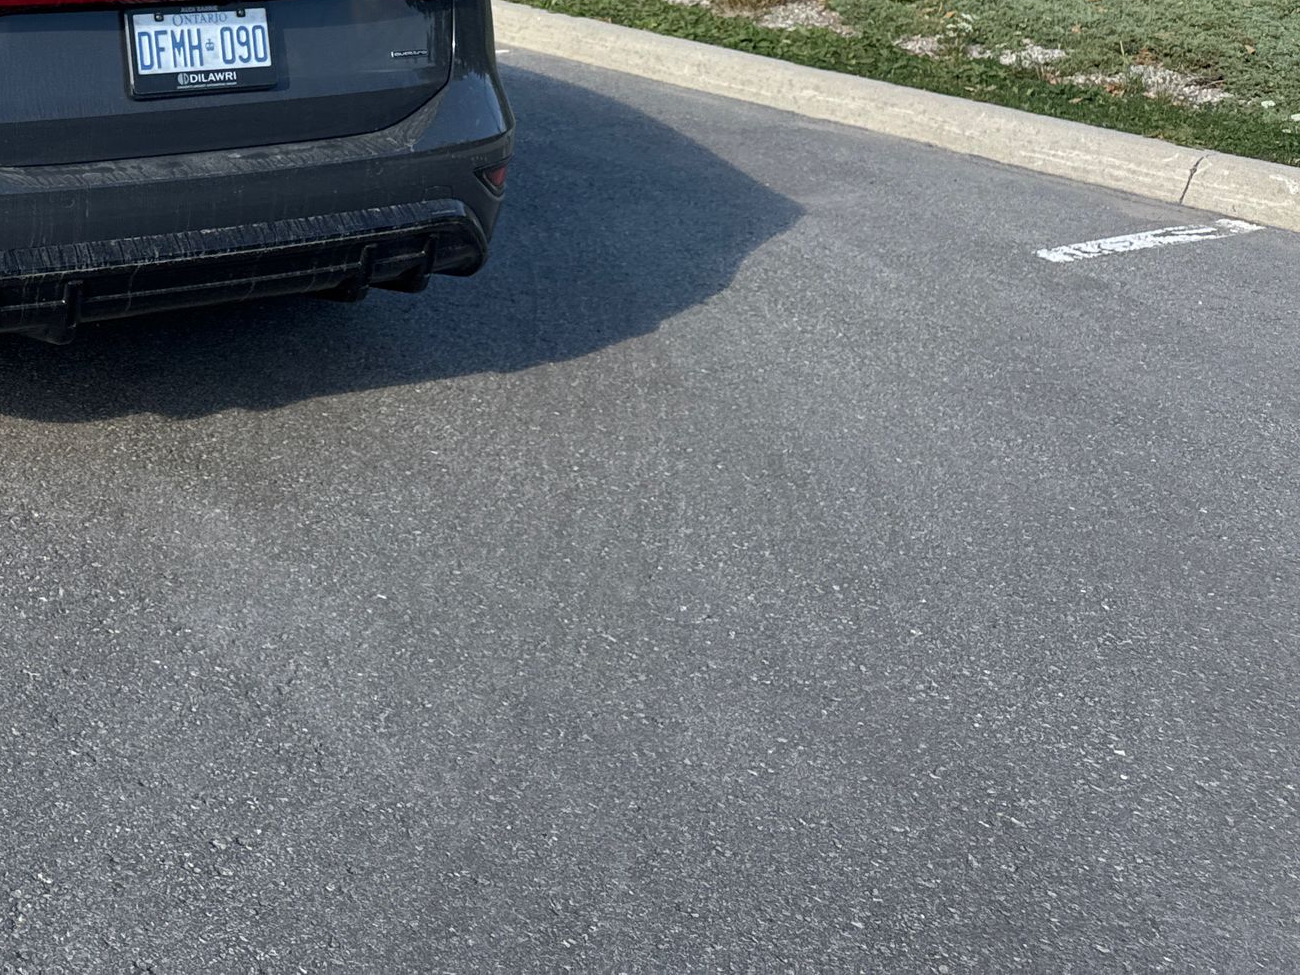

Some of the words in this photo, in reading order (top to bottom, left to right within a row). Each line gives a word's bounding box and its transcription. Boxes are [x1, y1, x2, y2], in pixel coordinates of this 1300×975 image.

[172, 12, 228, 26] ONTARIO
[137, 28, 204, 71] DFMH
[219, 25, 268, 65] 090
[189, 71, 237, 83] DILAWRI
